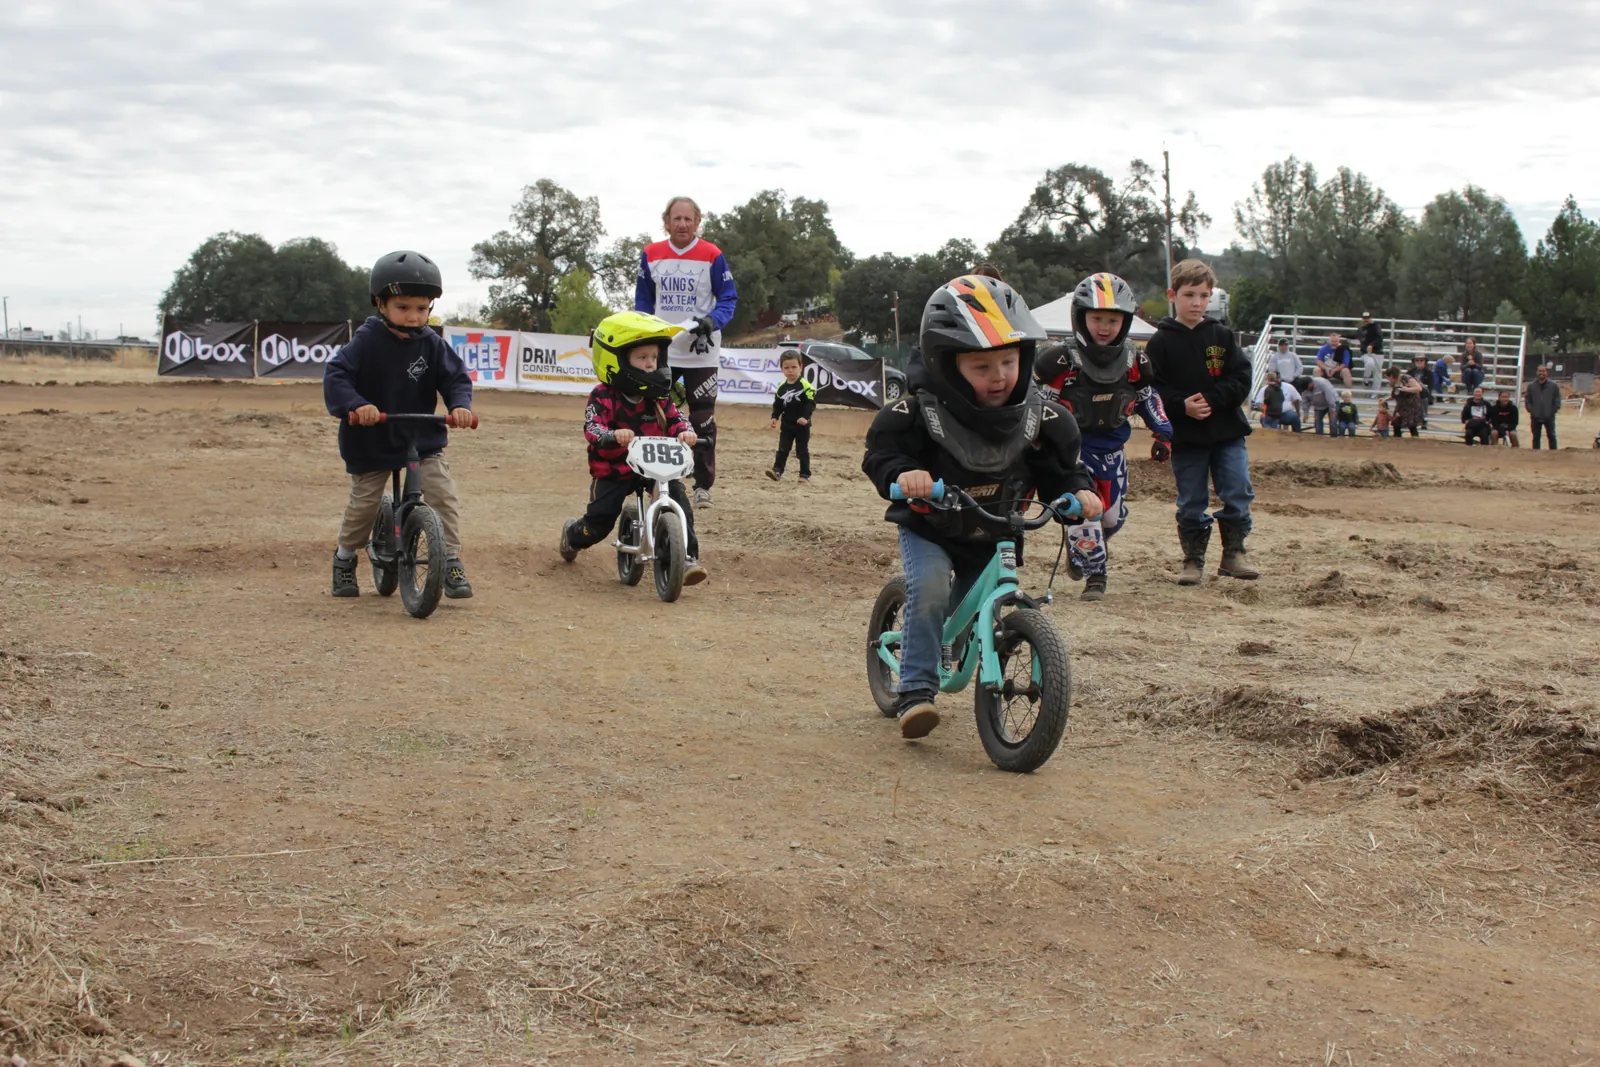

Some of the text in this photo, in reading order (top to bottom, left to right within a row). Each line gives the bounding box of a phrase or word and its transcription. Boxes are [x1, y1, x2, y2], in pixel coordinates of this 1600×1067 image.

[676, 294, 697, 306] TEAM
[523, 347, 557, 365] DRM
[522, 364, 597, 375] CONSTRUCTION
[642, 443, 684, 466] 893
